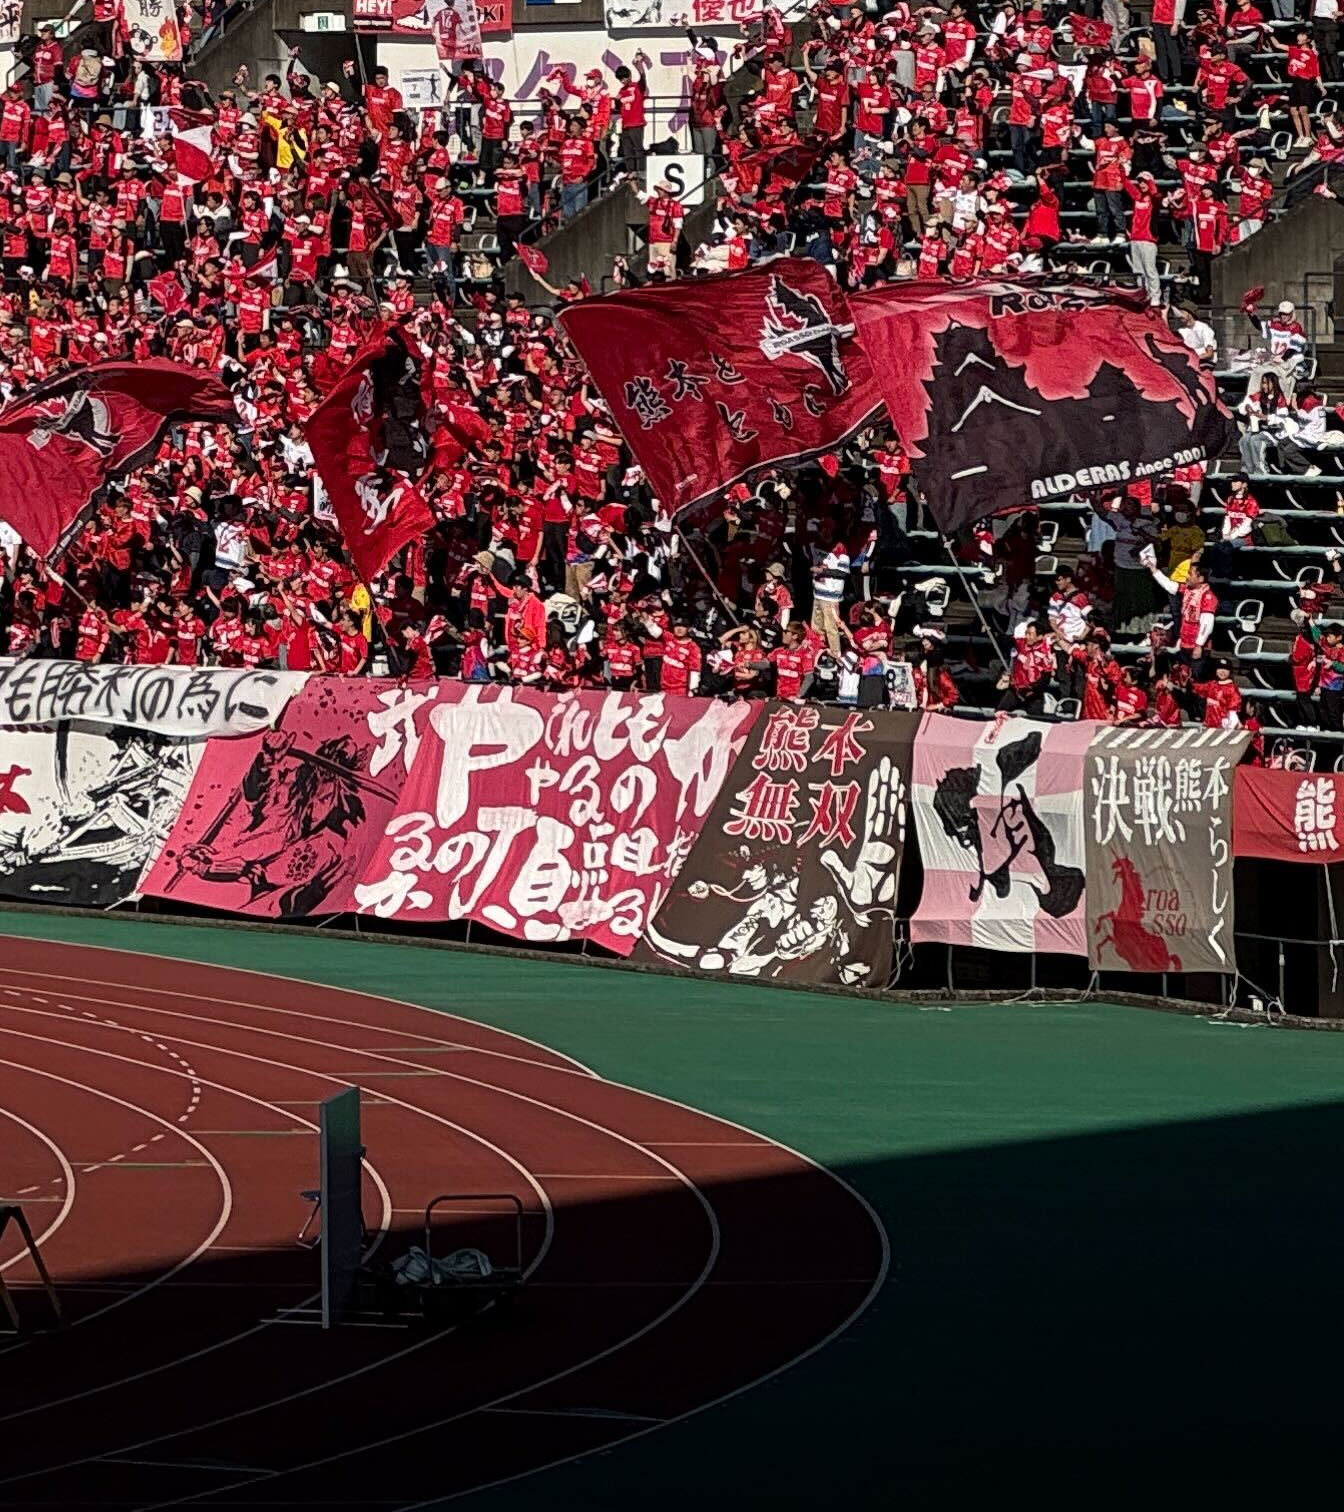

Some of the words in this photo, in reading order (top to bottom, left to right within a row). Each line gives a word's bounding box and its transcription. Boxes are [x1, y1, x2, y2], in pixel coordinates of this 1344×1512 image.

[356, 0, 394, 15] HEY!
[664, 163, 685, 193] S
[1031, 459, 1133, 500] ALDERAS
[1134, 456, 1174, 478] since
[1173, 444, 1207, 470] 2001
[752, 706, 875, 776] 熊本
[723, 772, 863, 849] 無双
[1294, 779, 1340, 854] 熊
